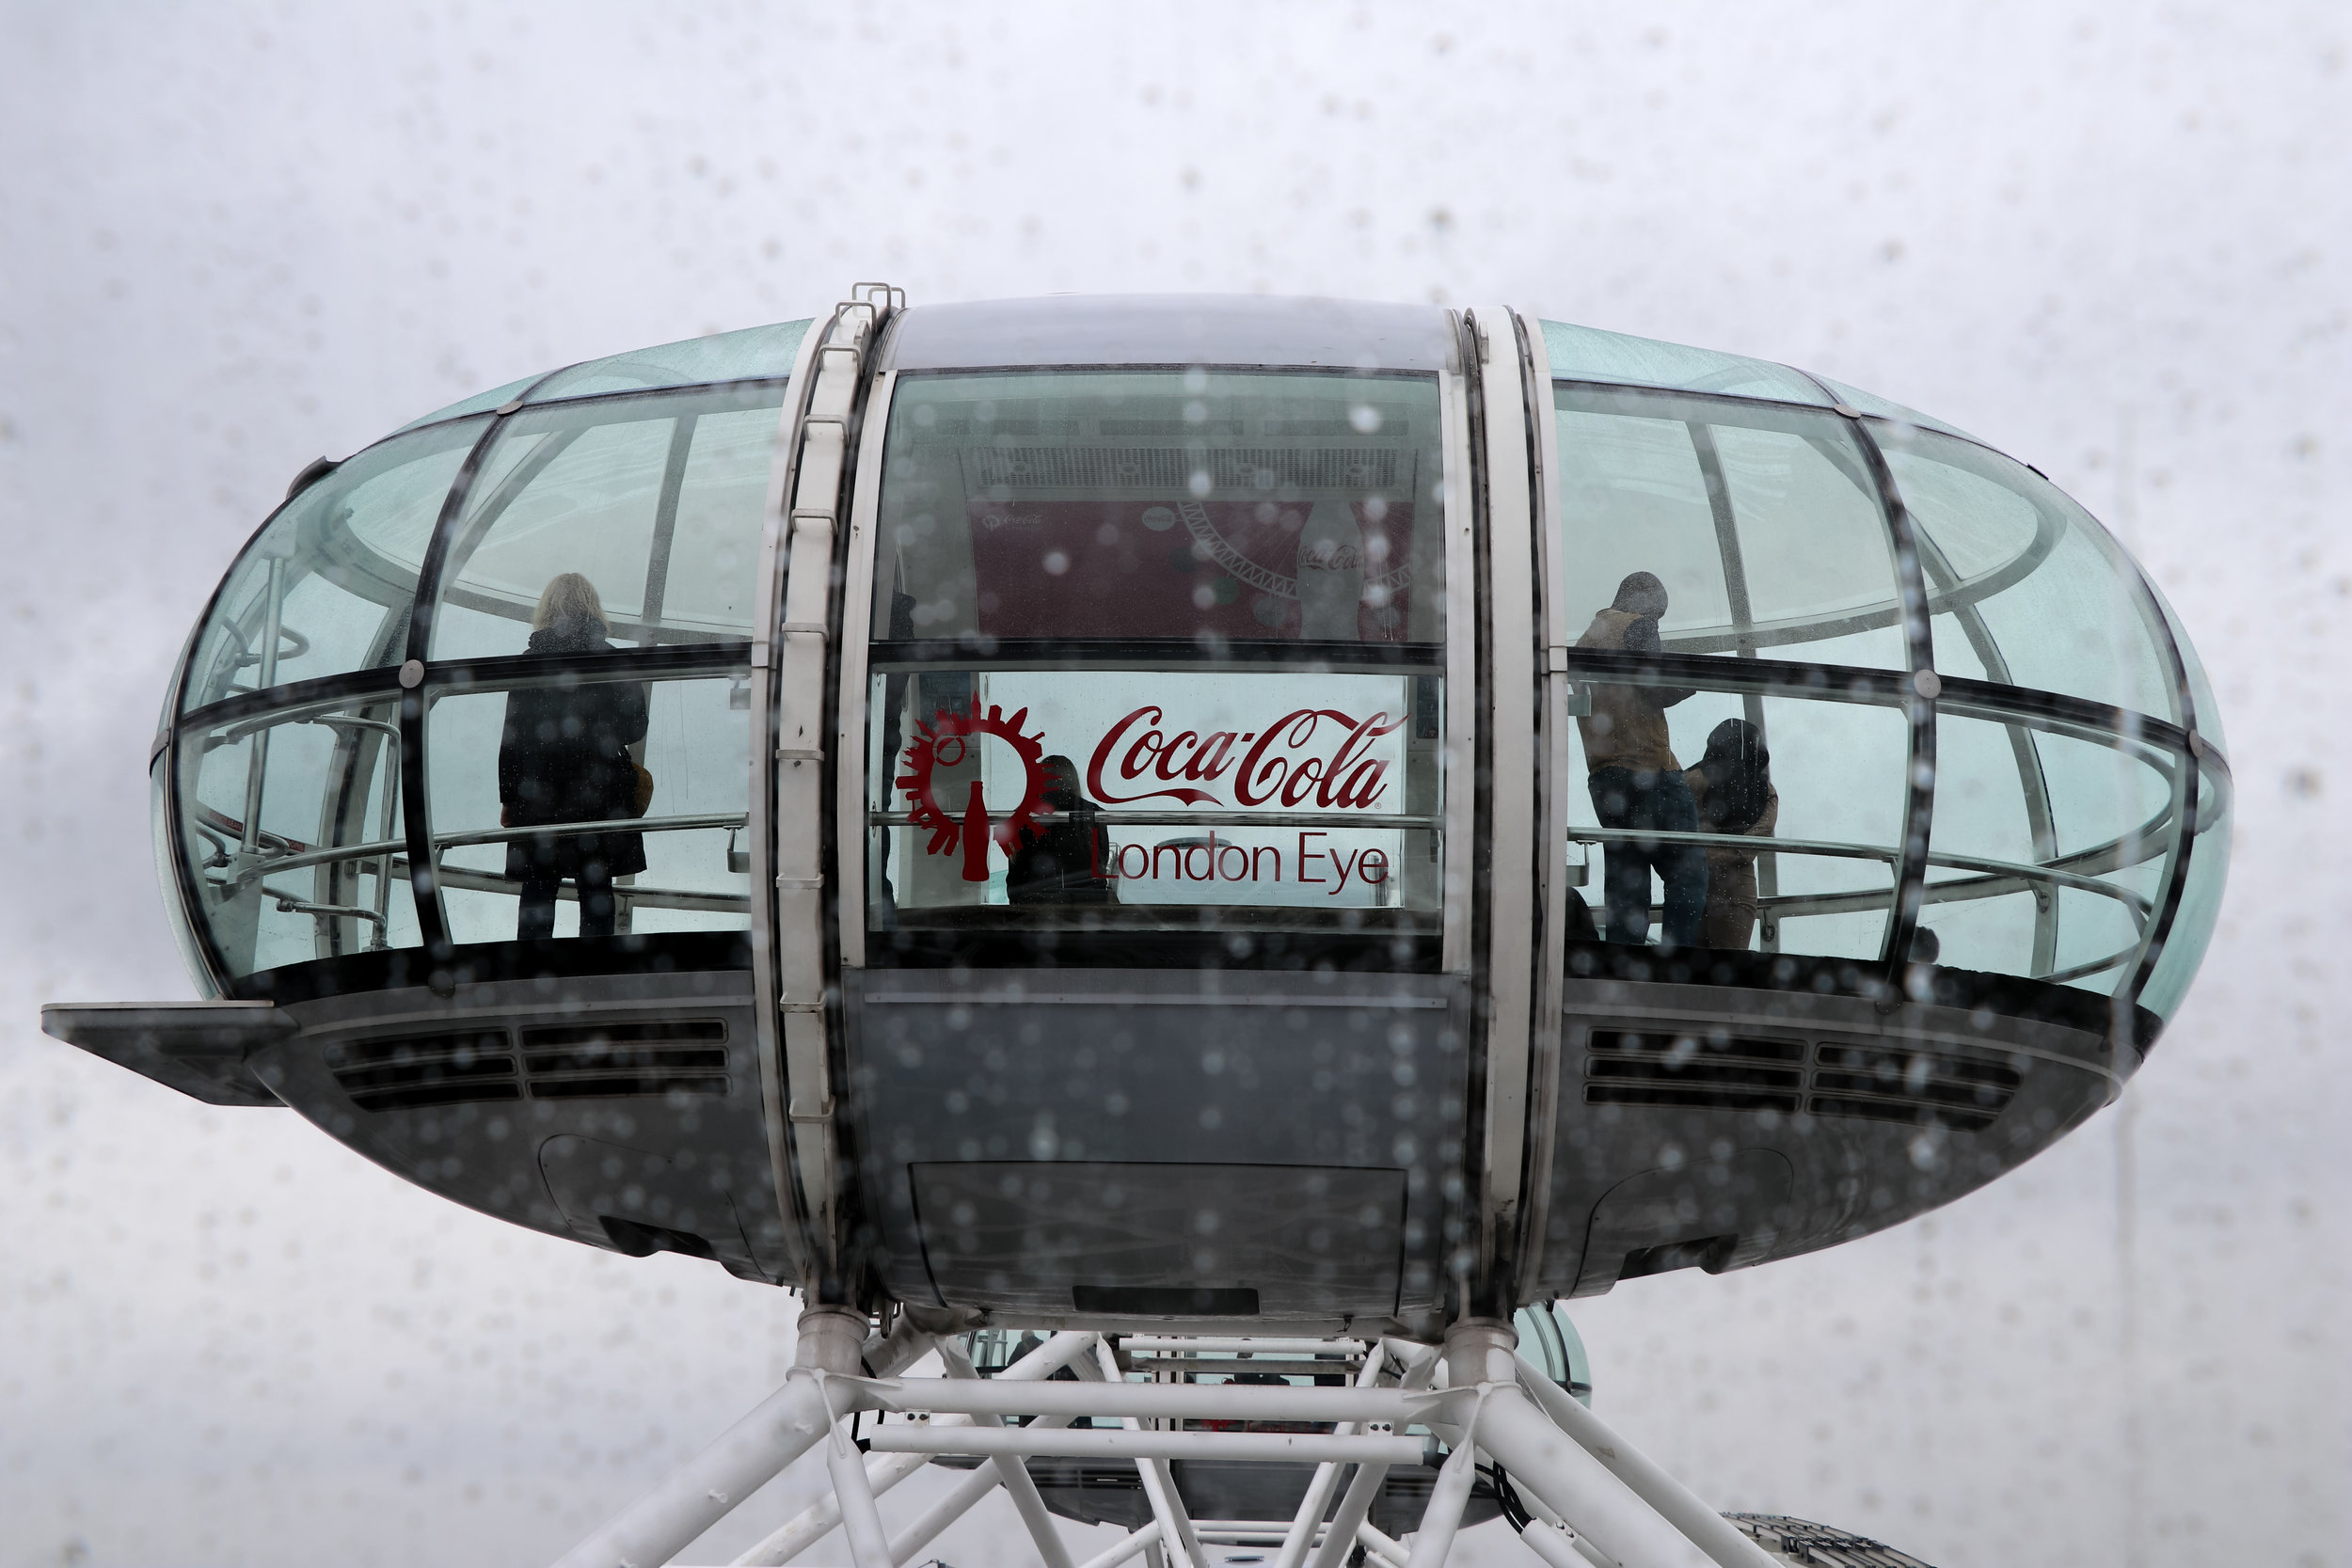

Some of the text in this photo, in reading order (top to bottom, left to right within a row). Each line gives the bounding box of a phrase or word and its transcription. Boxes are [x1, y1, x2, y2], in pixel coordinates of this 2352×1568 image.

[1087, 705, 1410, 808] Coca-Cola
[1091, 828, 1390, 895] London Eye
